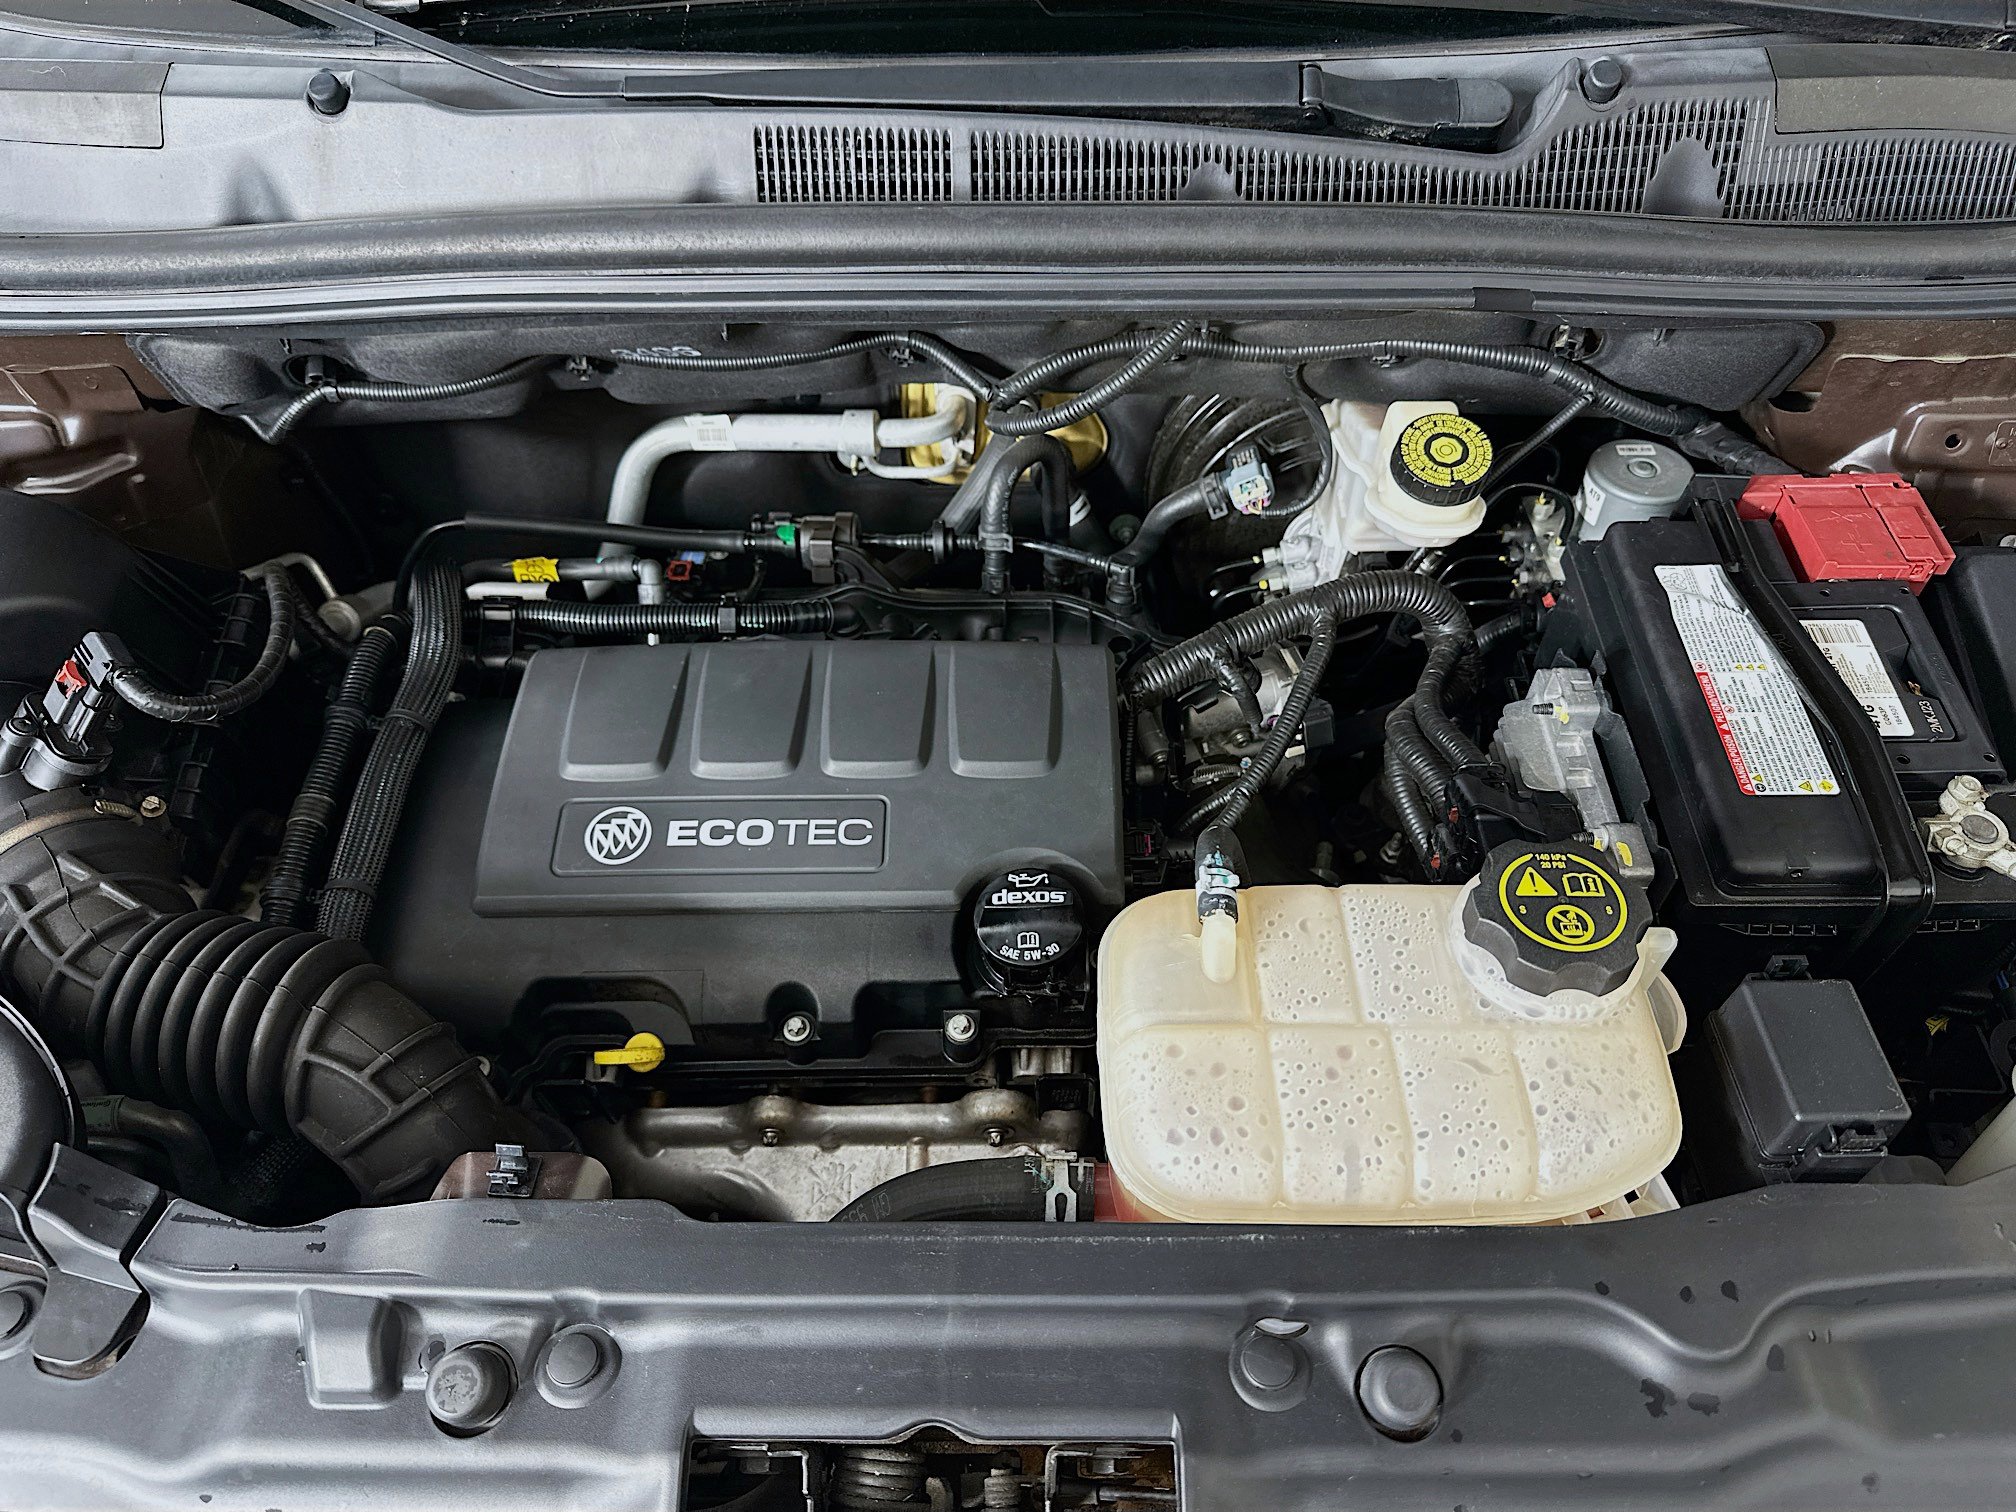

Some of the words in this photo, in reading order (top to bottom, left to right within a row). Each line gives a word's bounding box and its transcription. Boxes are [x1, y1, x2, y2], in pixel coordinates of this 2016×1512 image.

[1918, 700, 1944, 733] 2MKJ23
[666, 818, 874, 847] ECOTEC
[991, 888, 1067, 905] dexos
[999, 945, 1020, 960] SAE
[1023, 943, 1060, 960] 5W-30
